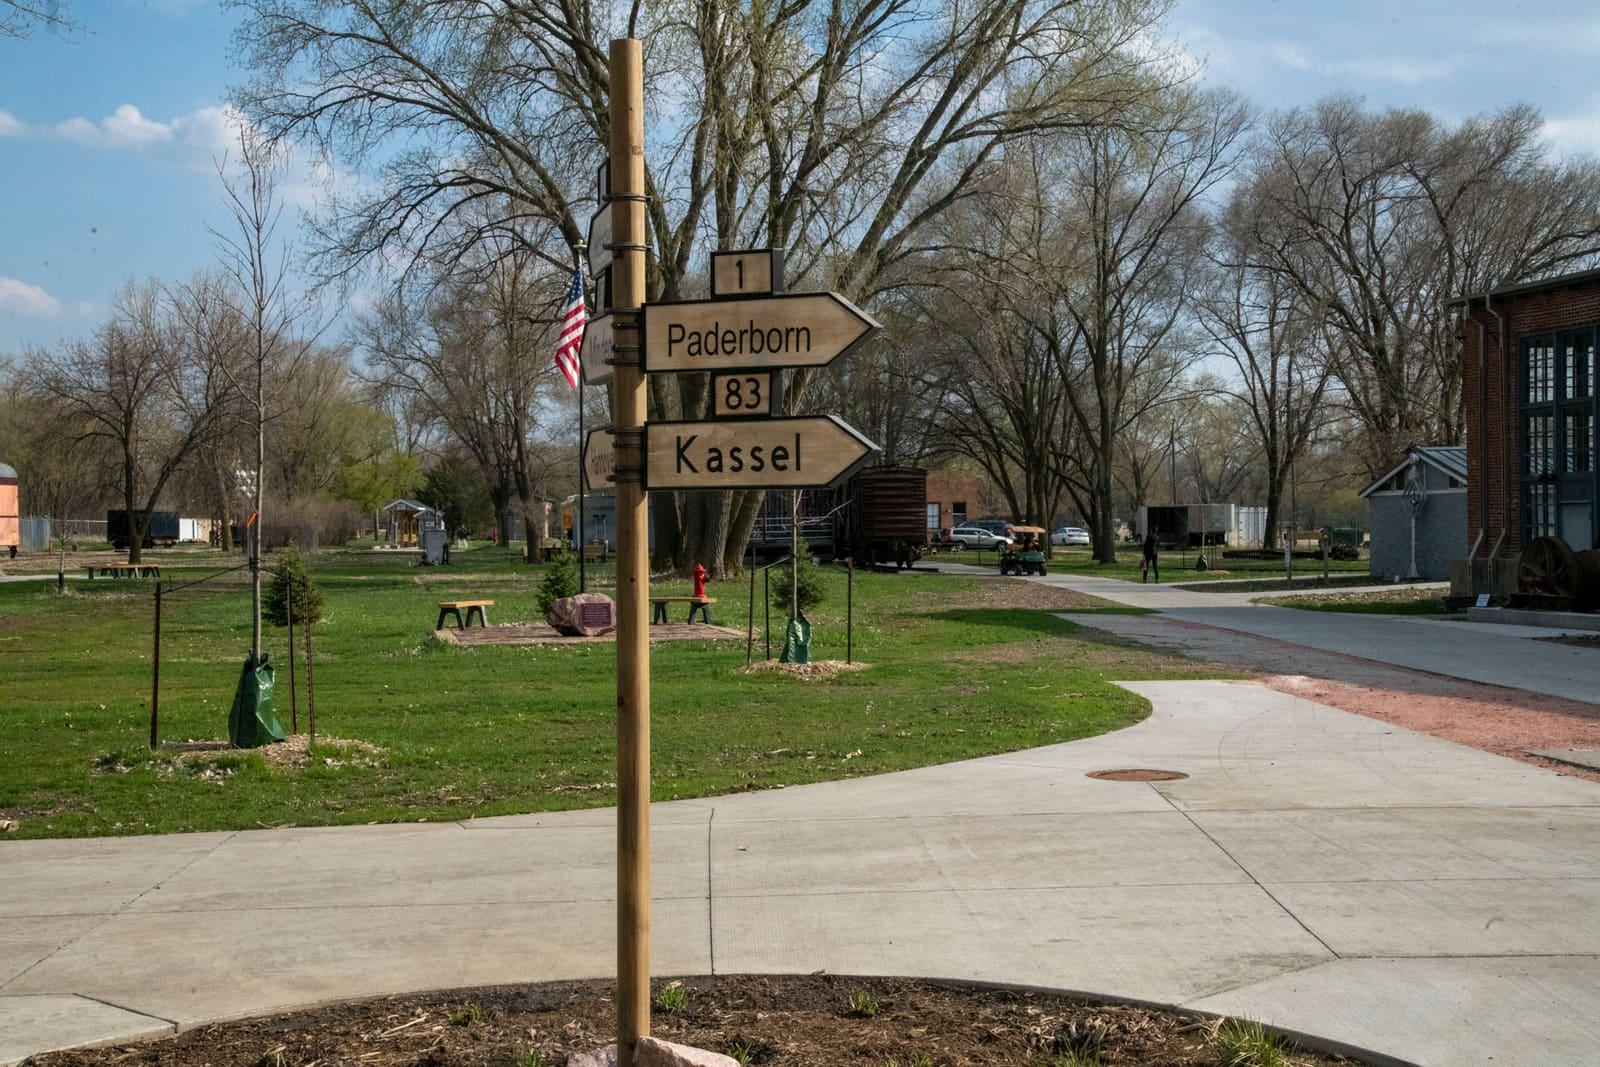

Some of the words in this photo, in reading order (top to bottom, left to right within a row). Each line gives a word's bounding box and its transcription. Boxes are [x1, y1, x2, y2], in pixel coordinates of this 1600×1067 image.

[735, 259, 744, 289] 1
[668, 320, 812, 357] Paderborn
[725, 378, 761, 410] 83
[676, 433, 801, 474] Kassel
